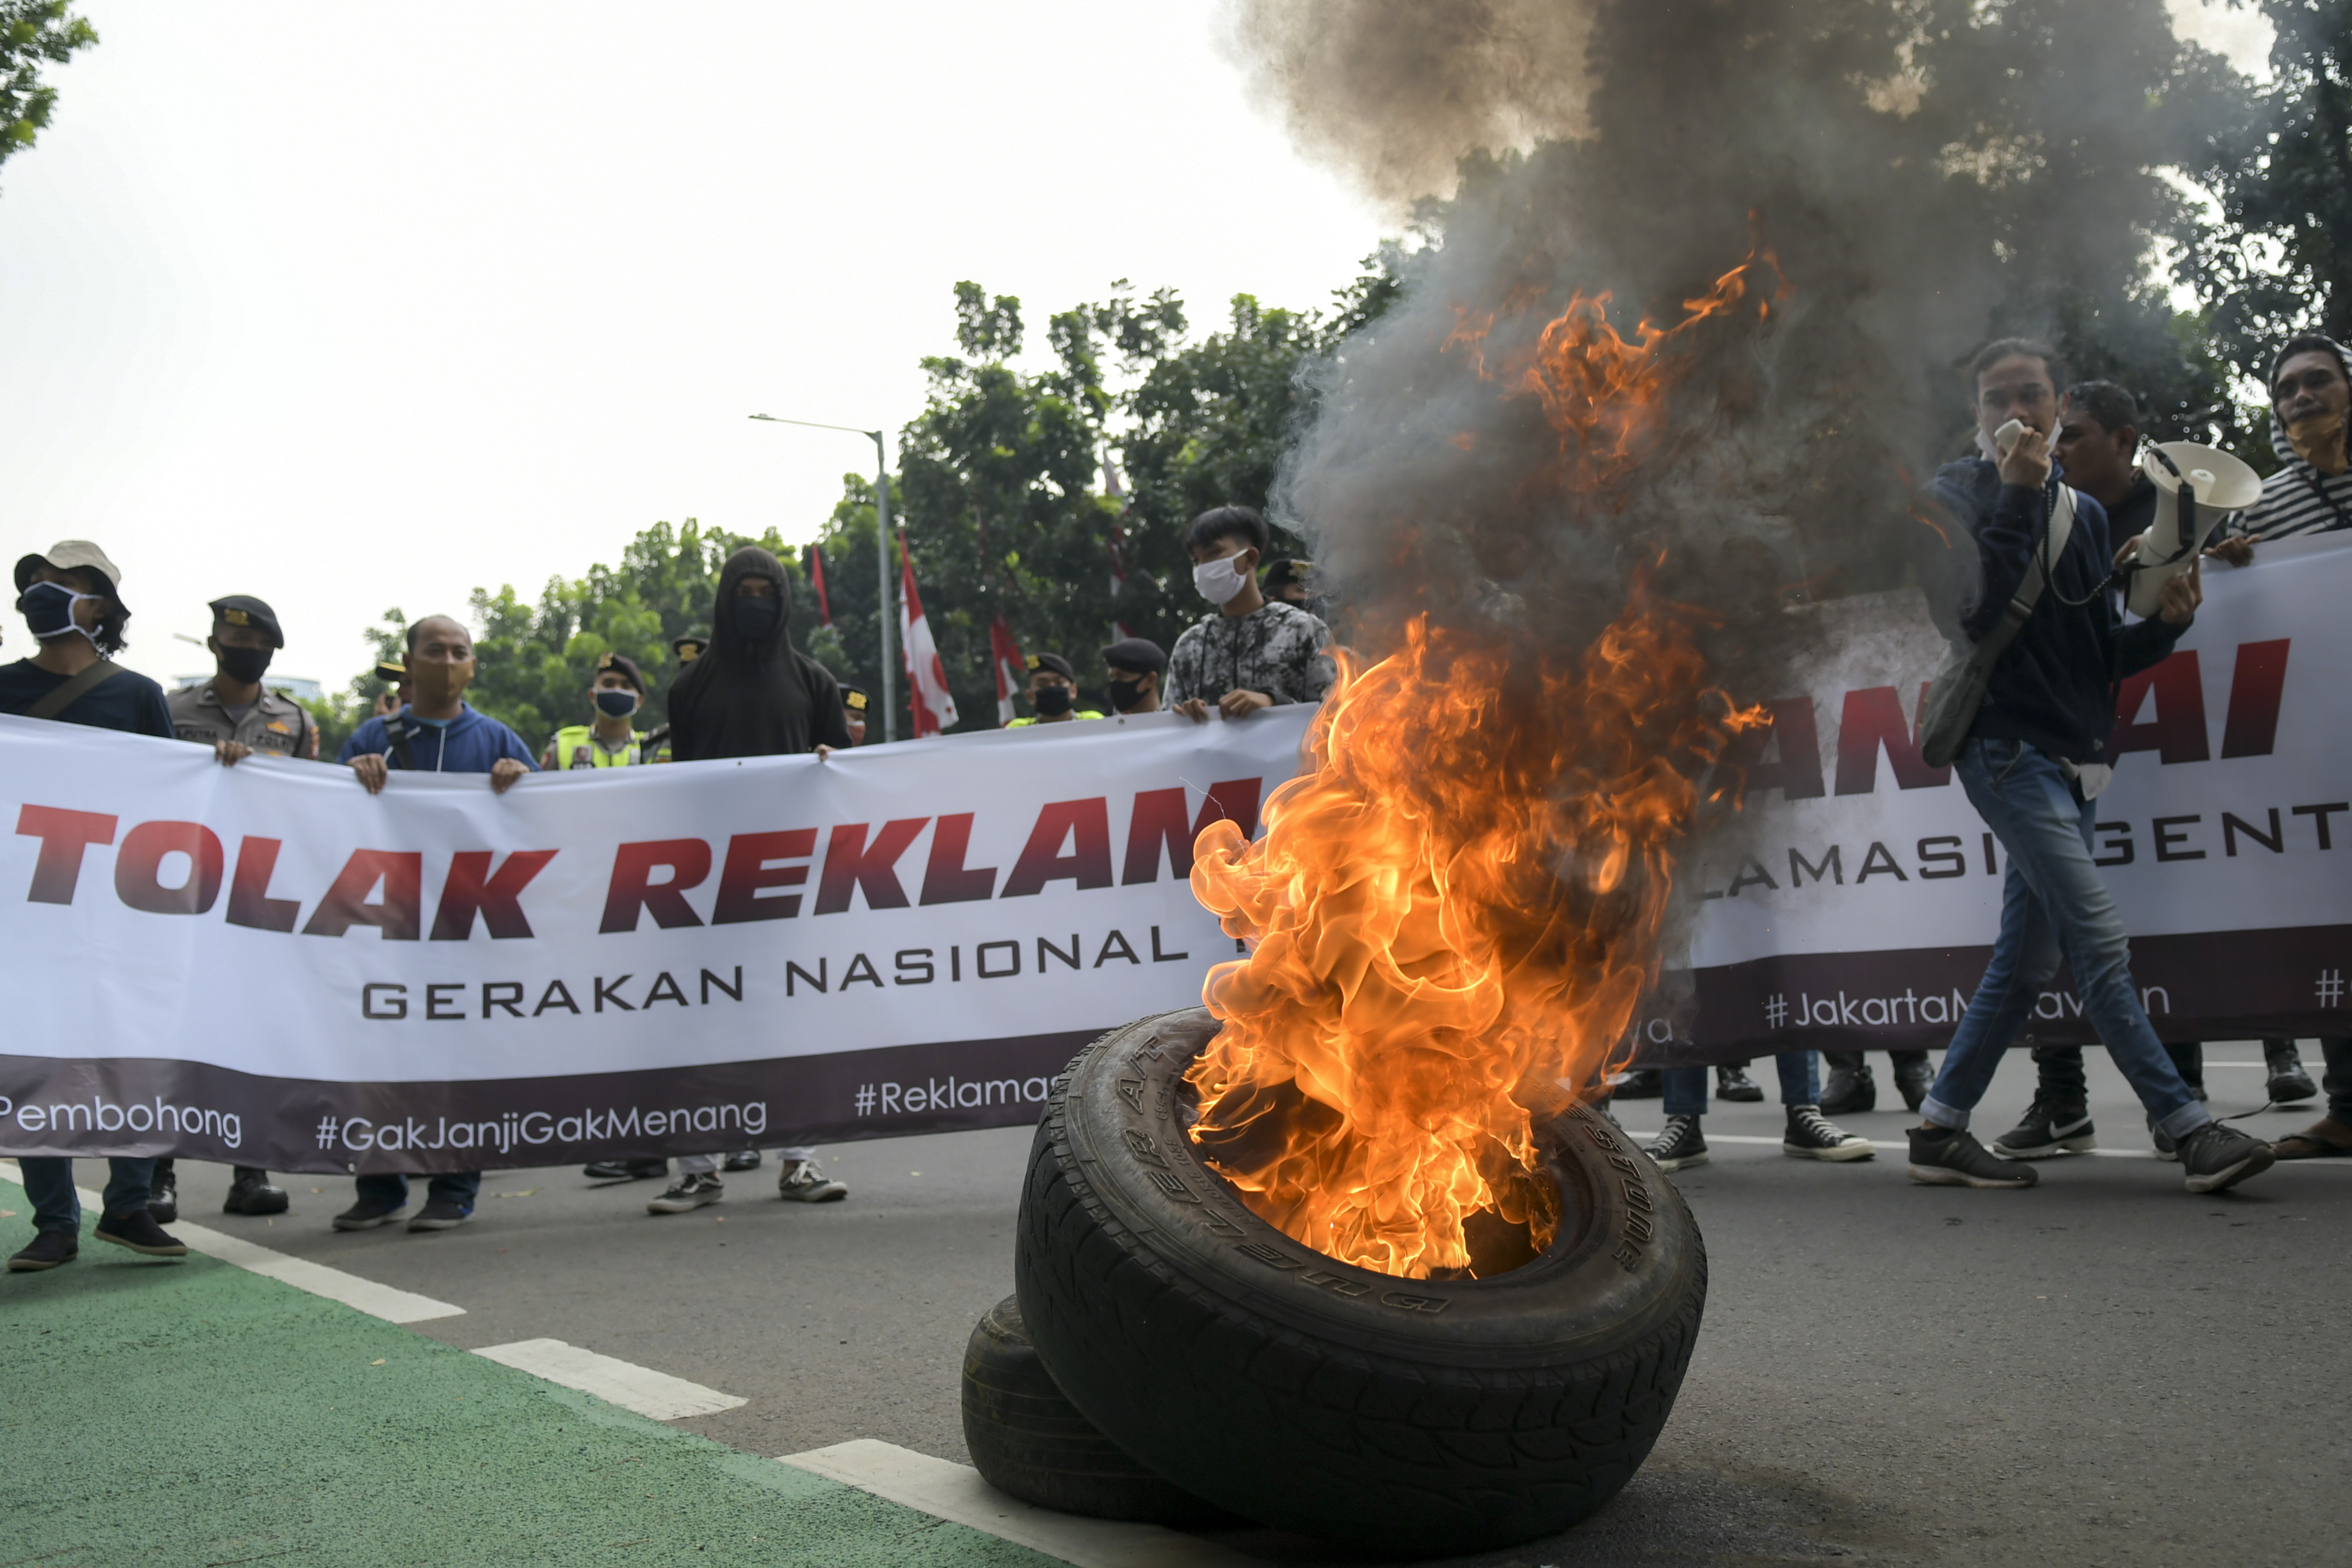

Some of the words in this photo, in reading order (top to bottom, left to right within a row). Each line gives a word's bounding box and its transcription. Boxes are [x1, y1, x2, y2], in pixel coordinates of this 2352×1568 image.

[15, 803, 560, 941] TOLAK
[598, 777, 1263, 934] REKLAM
[1707, 638, 2291, 801] ANAI
[362, 965, 743, 1021] GERAKAN
[786, 925, 1189, 997] NASIONAL
[2095, 801, 2350, 867] GENT
[315, 1101, 768, 1154] #GakJanjiGakMenang
[854, 1075, 1060, 1117] #Reklama
